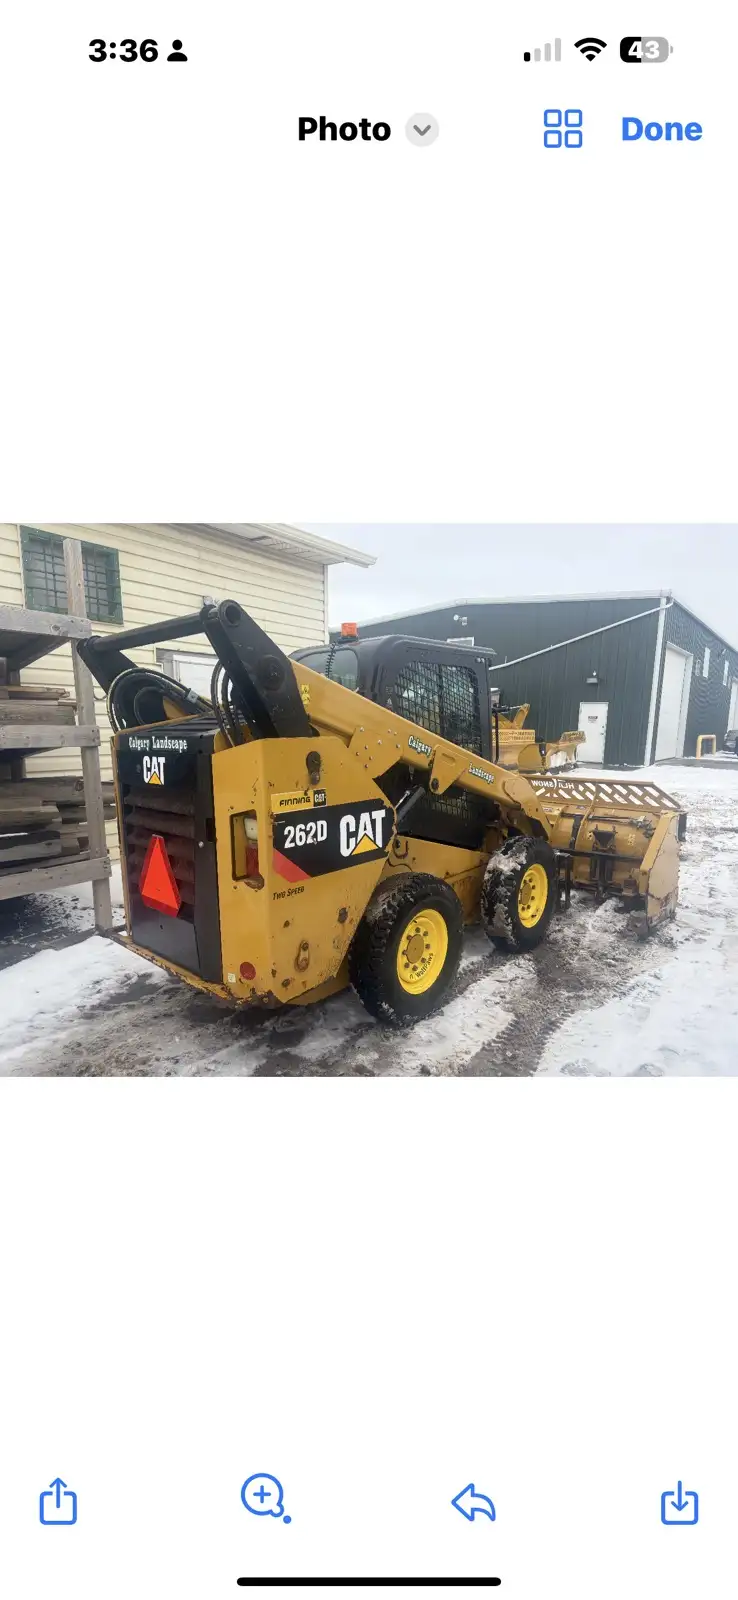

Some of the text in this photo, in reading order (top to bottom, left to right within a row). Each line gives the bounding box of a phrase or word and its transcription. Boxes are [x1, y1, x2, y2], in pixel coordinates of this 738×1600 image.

[128, 736, 188, 753] Calgary Landscape
[143, 756, 165, 785] CAT
[408, 735, 494, 784] Calgary Landscape
[279, 796, 311, 807] FINNING
[314, 793, 325, 803] CAT
[283, 820, 328, 849] 262D
[339, 809, 386, 857] CAT
